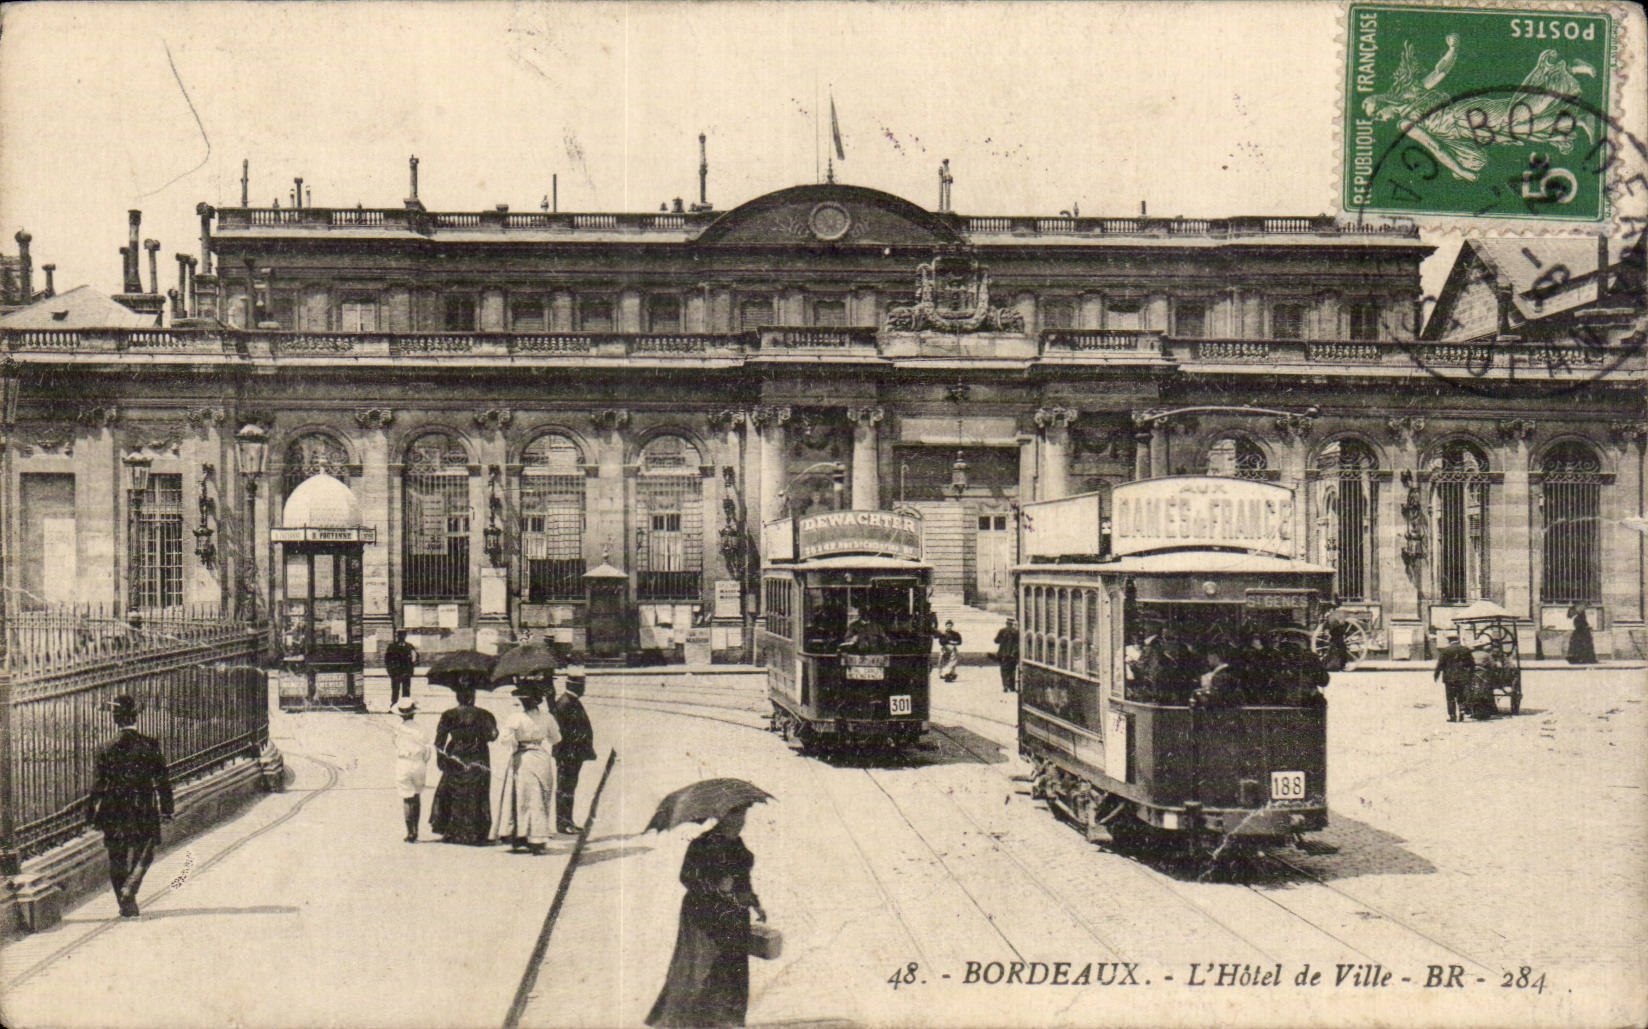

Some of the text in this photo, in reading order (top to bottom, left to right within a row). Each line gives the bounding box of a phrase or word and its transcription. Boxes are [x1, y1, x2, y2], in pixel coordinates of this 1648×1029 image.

[1510, 19, 1595, 41] POSTES
[1357, 12, 1378, 92] FRANÇAISE
[1179, 485, 1229, 494] AUX
[803, 513, 916, 533] DEWACHTER
[891, 698, 911, 712] 301
[1274, 776, 1302, 796] 188
